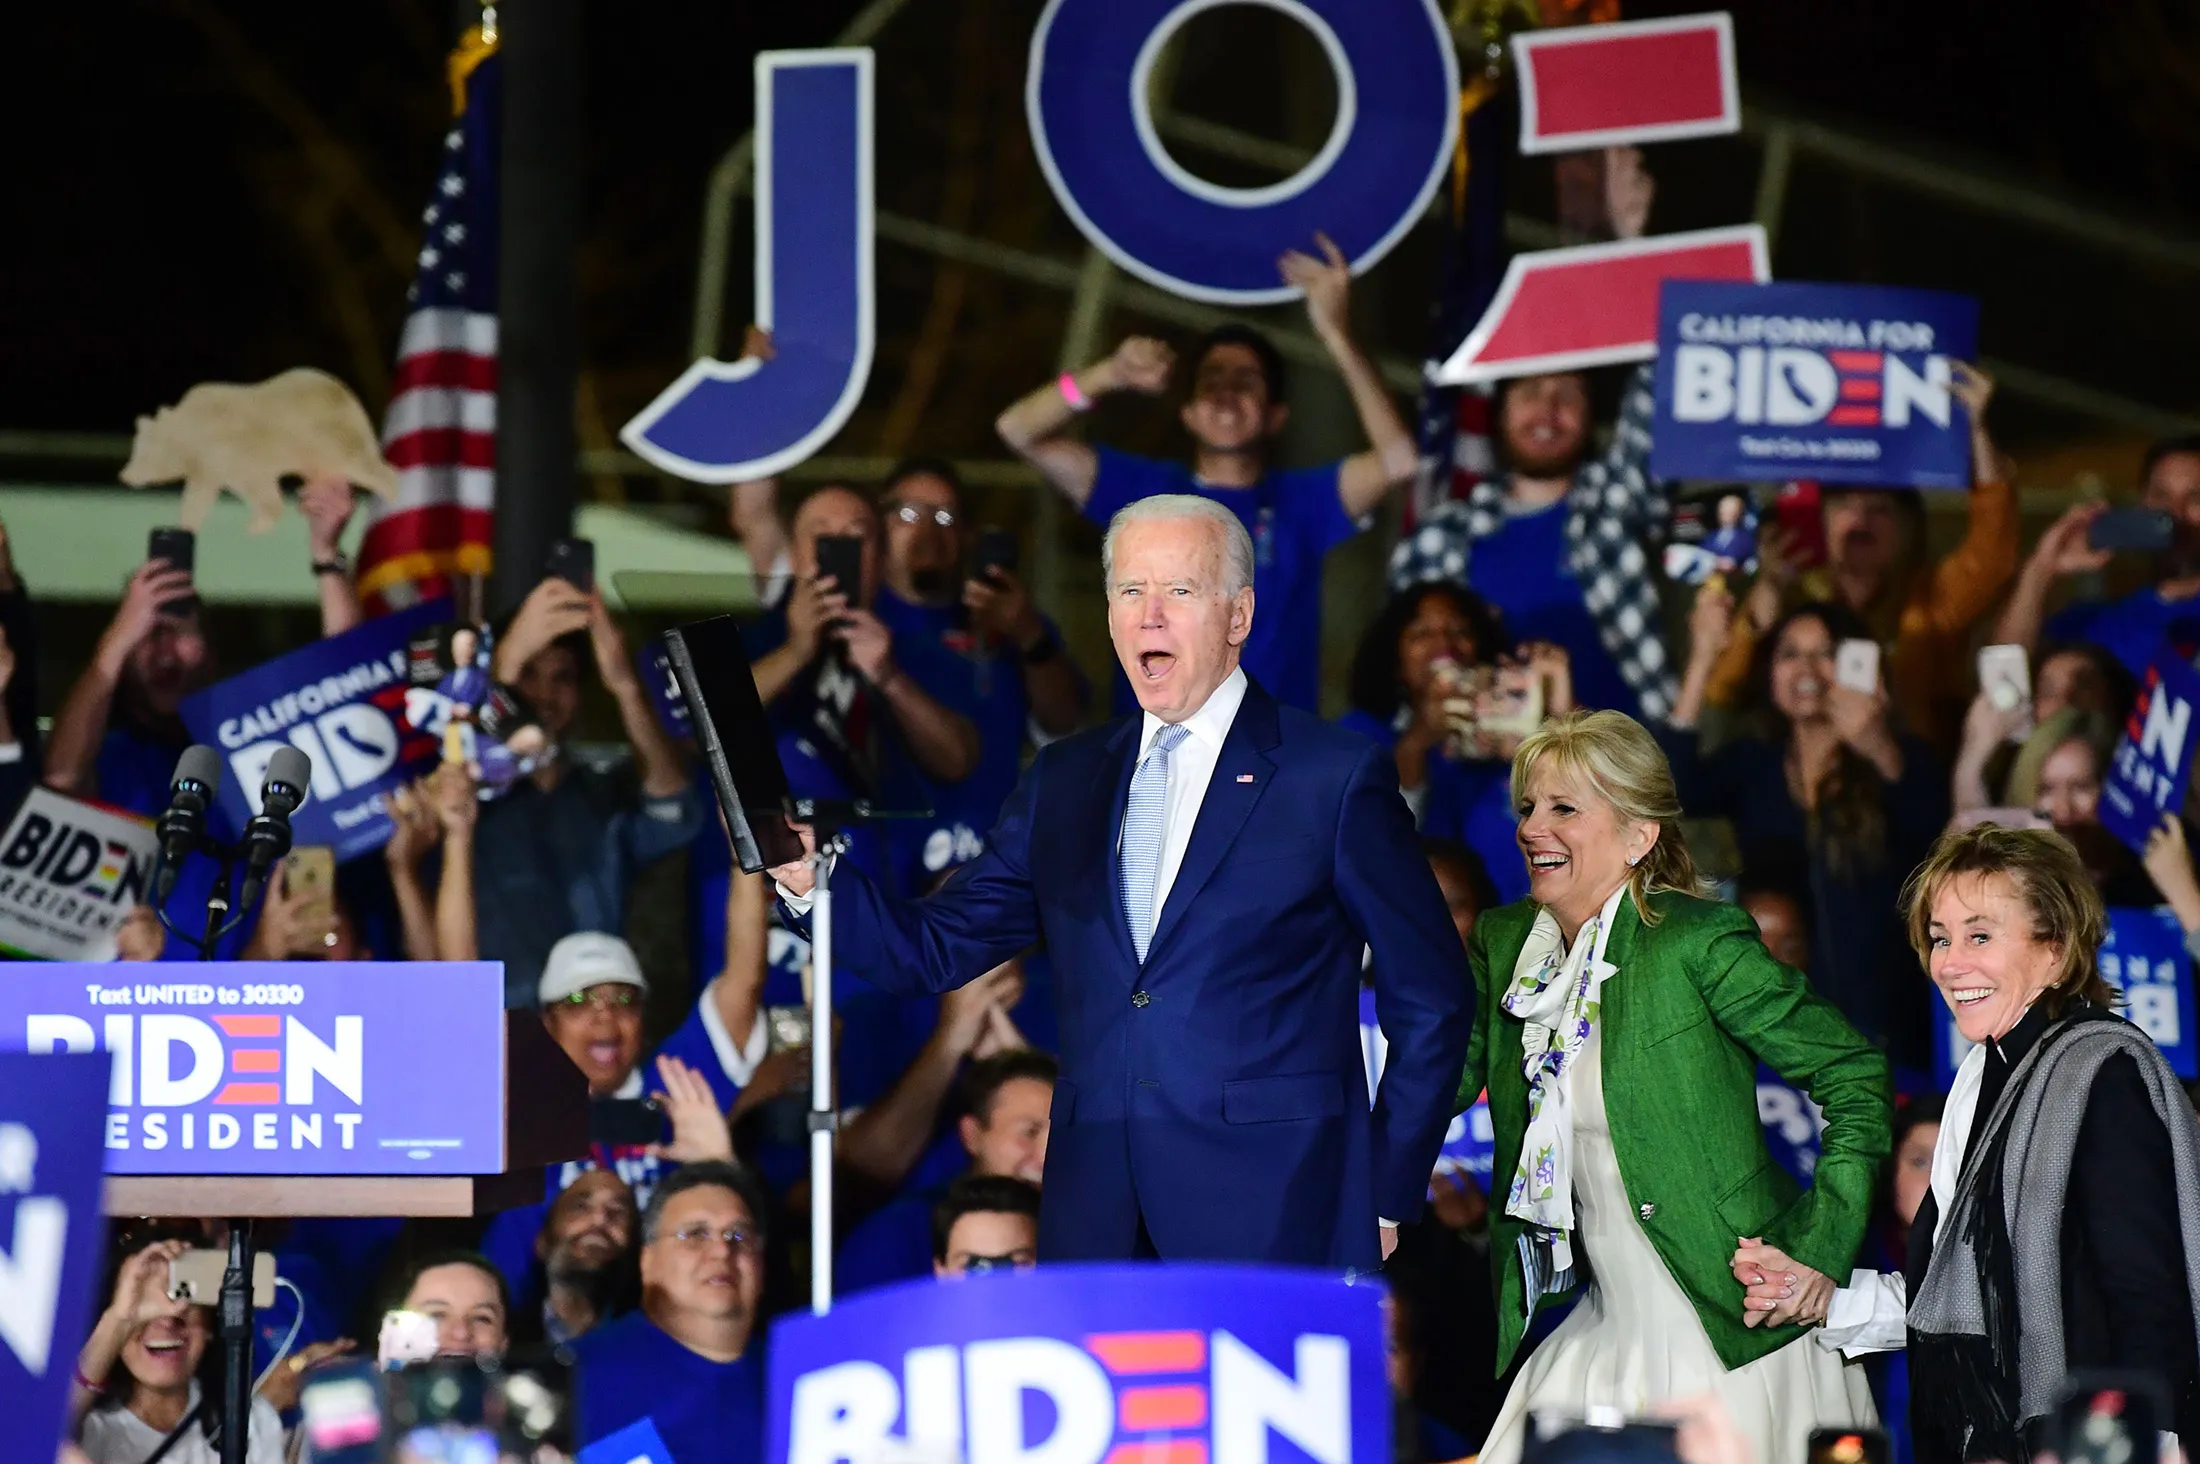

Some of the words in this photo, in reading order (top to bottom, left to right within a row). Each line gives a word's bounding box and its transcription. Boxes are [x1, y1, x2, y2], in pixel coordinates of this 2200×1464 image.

[1678, 312, 1866, 348] CALIFORNIA
[1868, 319, 1935, 351] FOR
[1672, 343, 1952, 430] BIDEN
[218, 659, 392, 749] CALIFORNIA
[1, 812, 154, 906] BIDEN
[86, 984, 132, 1006] Text
[135, 984, 214, 1006] UNITED
[217, 984, 241, 1006] to
[242, 984, 304, 1006] 30330
[105, 1113, 362, 1151] ESIDENT
[789, 1328, 1352, 1464] BIDEN
